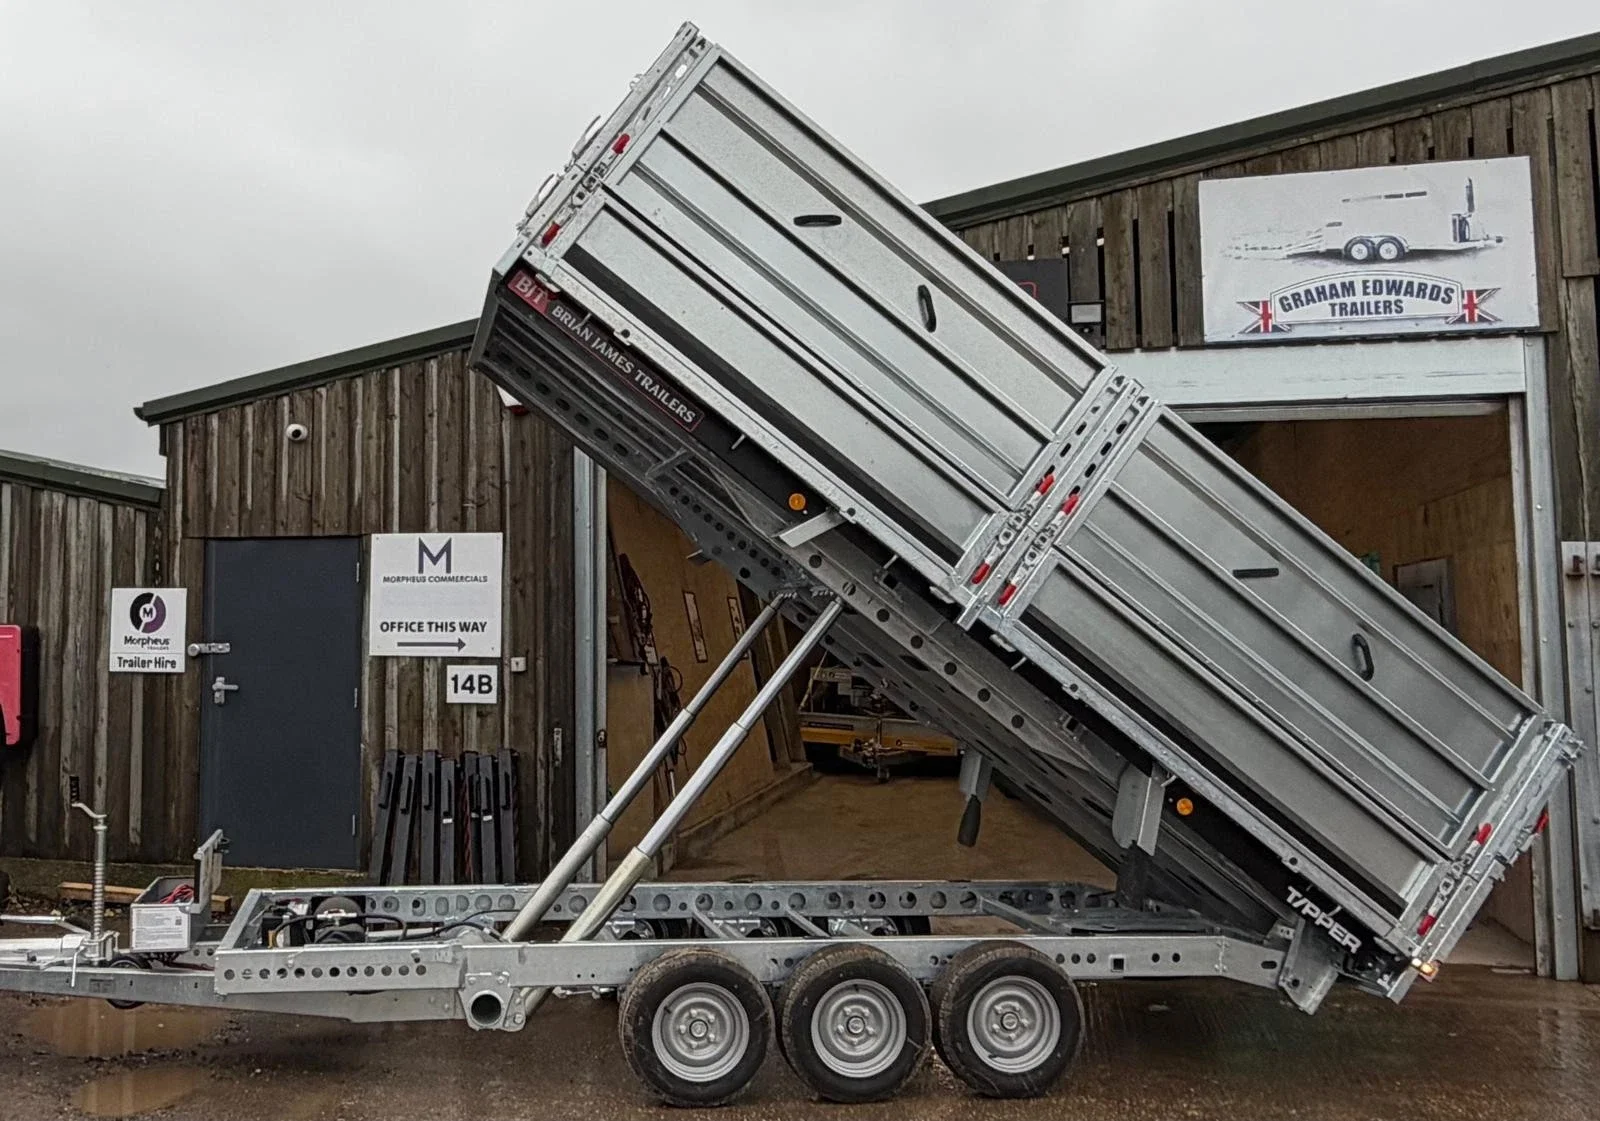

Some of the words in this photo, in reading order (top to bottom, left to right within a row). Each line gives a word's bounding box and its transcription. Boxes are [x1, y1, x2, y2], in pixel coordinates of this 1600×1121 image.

[514, 276, 545, 304] BJT
[1279, 280, 1356, 313] GRAHAM
[1362, 279, 1455, 305] EDWARDS
[1328, 299, 1404, 318] TRAILERS
[551, 305, 594, 342] BRIAN
[591, 337, 635, 374] JAMES
[634, 369, 696, 424] TRAILERS
[382, 575, 427, 583] MORPHEUS
[428, 575, 489, 583] COMMERCIALS
[142, 607, 154, 619] M
[379, 621, 425, 633] OFFICE
[426, 621, 457, 633] THIS
[458, 621, 488, 633] WAY
[123, 635, 170, 648] Morpheus
[117, 655, 153, 668] Trailer
[154, 656, 177, 669] Hire
[450, 673, 493, 694] 14B
[1286, 886, 1361, 954] TIPPER
